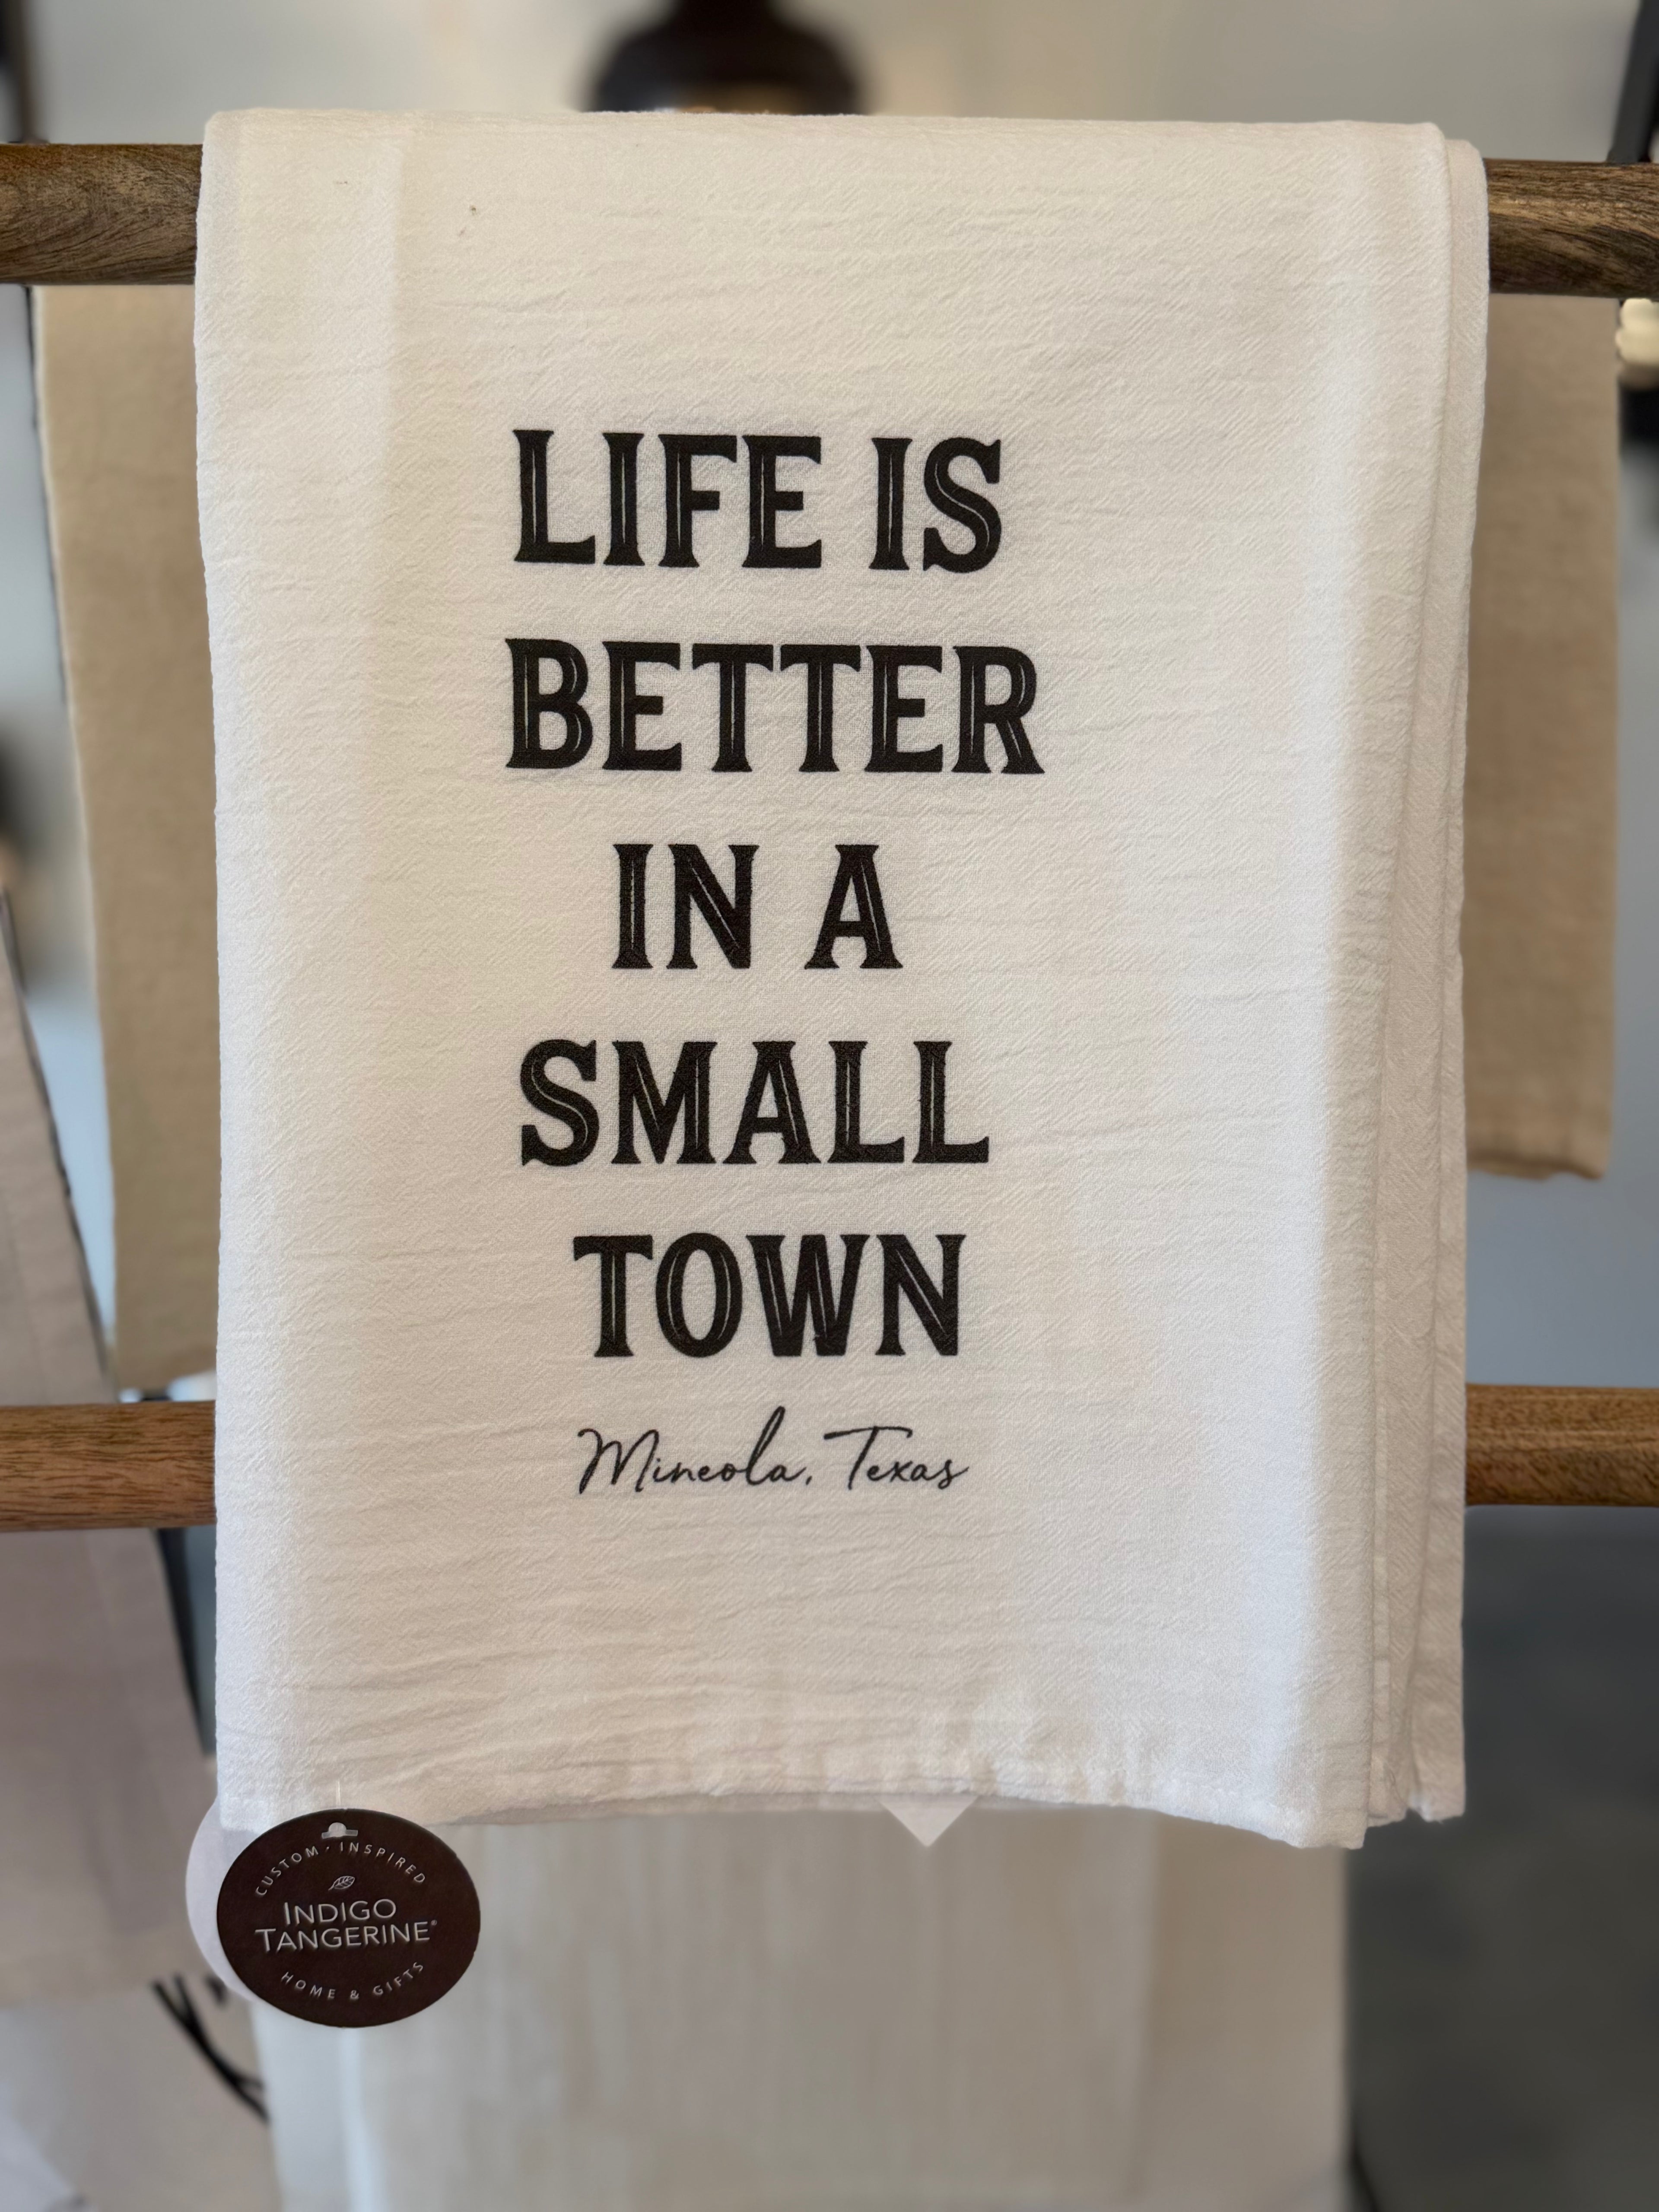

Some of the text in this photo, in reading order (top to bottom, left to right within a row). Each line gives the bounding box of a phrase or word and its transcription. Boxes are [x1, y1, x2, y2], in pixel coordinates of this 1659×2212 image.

[513, 429, 1001, 573] LIFE IS
[505, 638, 1045, 774] BETTER
[612, 843, 903, 969] IN A
[520, 1039, 989, 1167] SMALL
[573, 1233, 966, 1358] TOWN
[823, 1426, 969, 1491] Texas
[255, 1841, 426, 1897] CUSTOM INSPIRED
[283, 1899, 397, 1925] INDIGO
[281, 1961, 423, 2000] HOME & GIFTS
